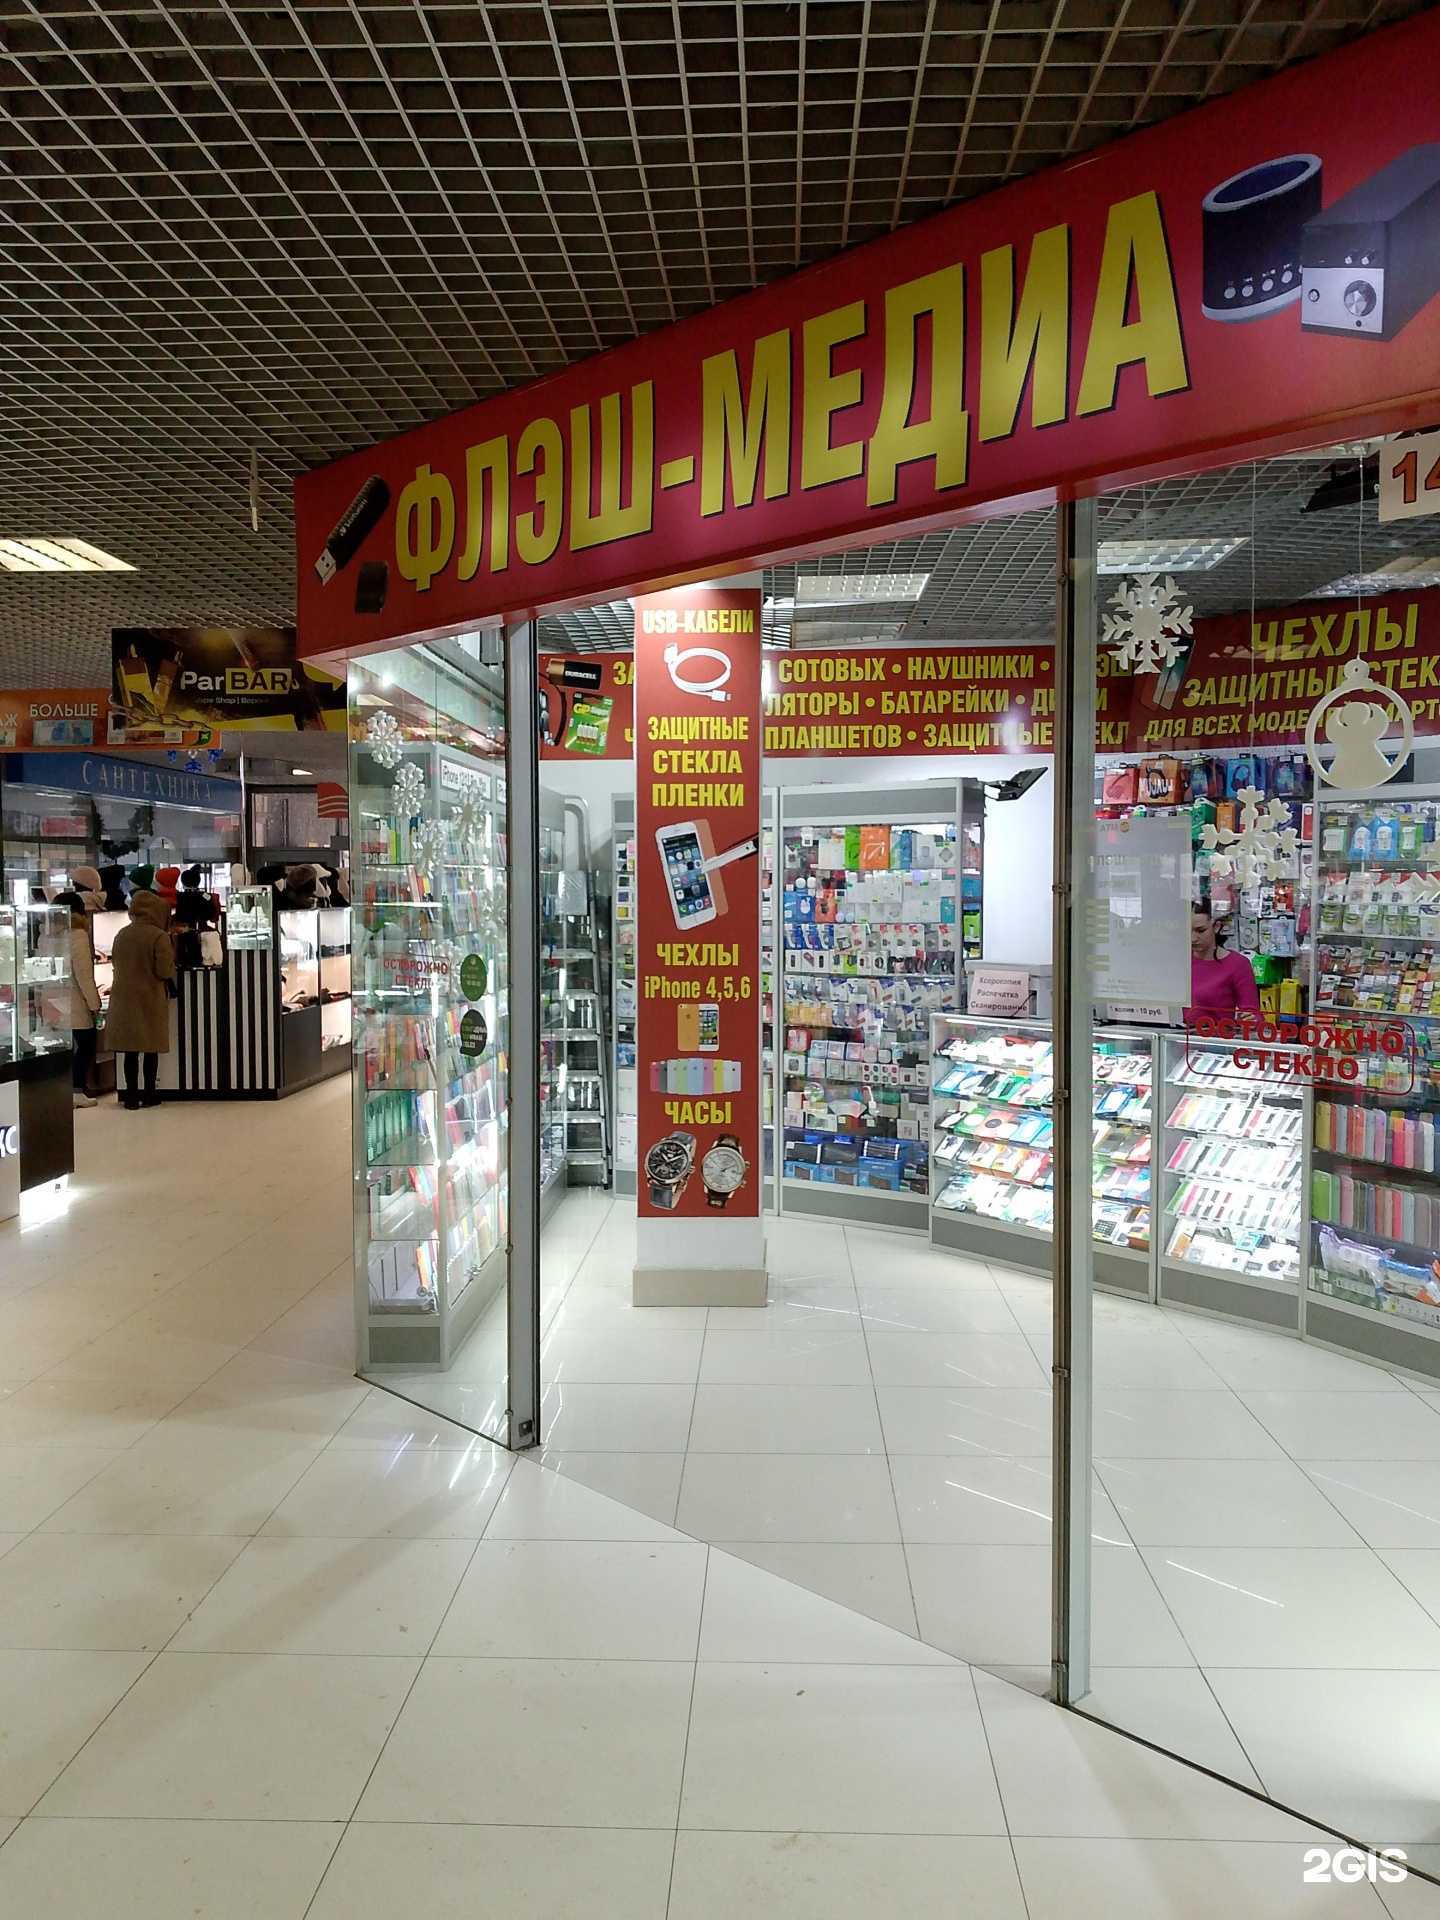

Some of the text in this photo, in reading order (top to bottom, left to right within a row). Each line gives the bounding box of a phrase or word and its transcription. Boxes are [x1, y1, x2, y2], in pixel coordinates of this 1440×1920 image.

[395, 190, 1190, 592] ФЛЭШ-МЕДИА
[642, 609, 754, 634] USB-КАБЕЛИ
[1253, 603, 1419, 663] ЧЕХЛЫ
[778, 657, 886, 683] СОТОВЫХ
[907, 655, 1034, 680] НАУШНИКИ
[30, 703, 98, 717] БОЛЬШЕ
[881, 684, 1009, 714] БАТАРЕЙКИ
[648, 716, 749, 744] ЗАЩИТНЫЕ
[764, 724, 902, 750] ПЛАНШЕТОВ
[1144, 718, 1186, 742] ДЛЯ
[1191, 714, 1241, 737] ВСЕХ
[653, 750, 743, 775] СТЕКЛА
[652, 784, 744, 808] ПЛЕНКИ
[656, 943, 739, 966] ЧЕХЛЫ
[644, 976, 751, 1002] iPhone 4,5,6
[1195, 1015, 1404, 1056] ОСТОРОЖНО
[1232, 1047, 1359, 1080] СТЕКЛО
[664, 1101, 734, 1125] ЧАСЫ
